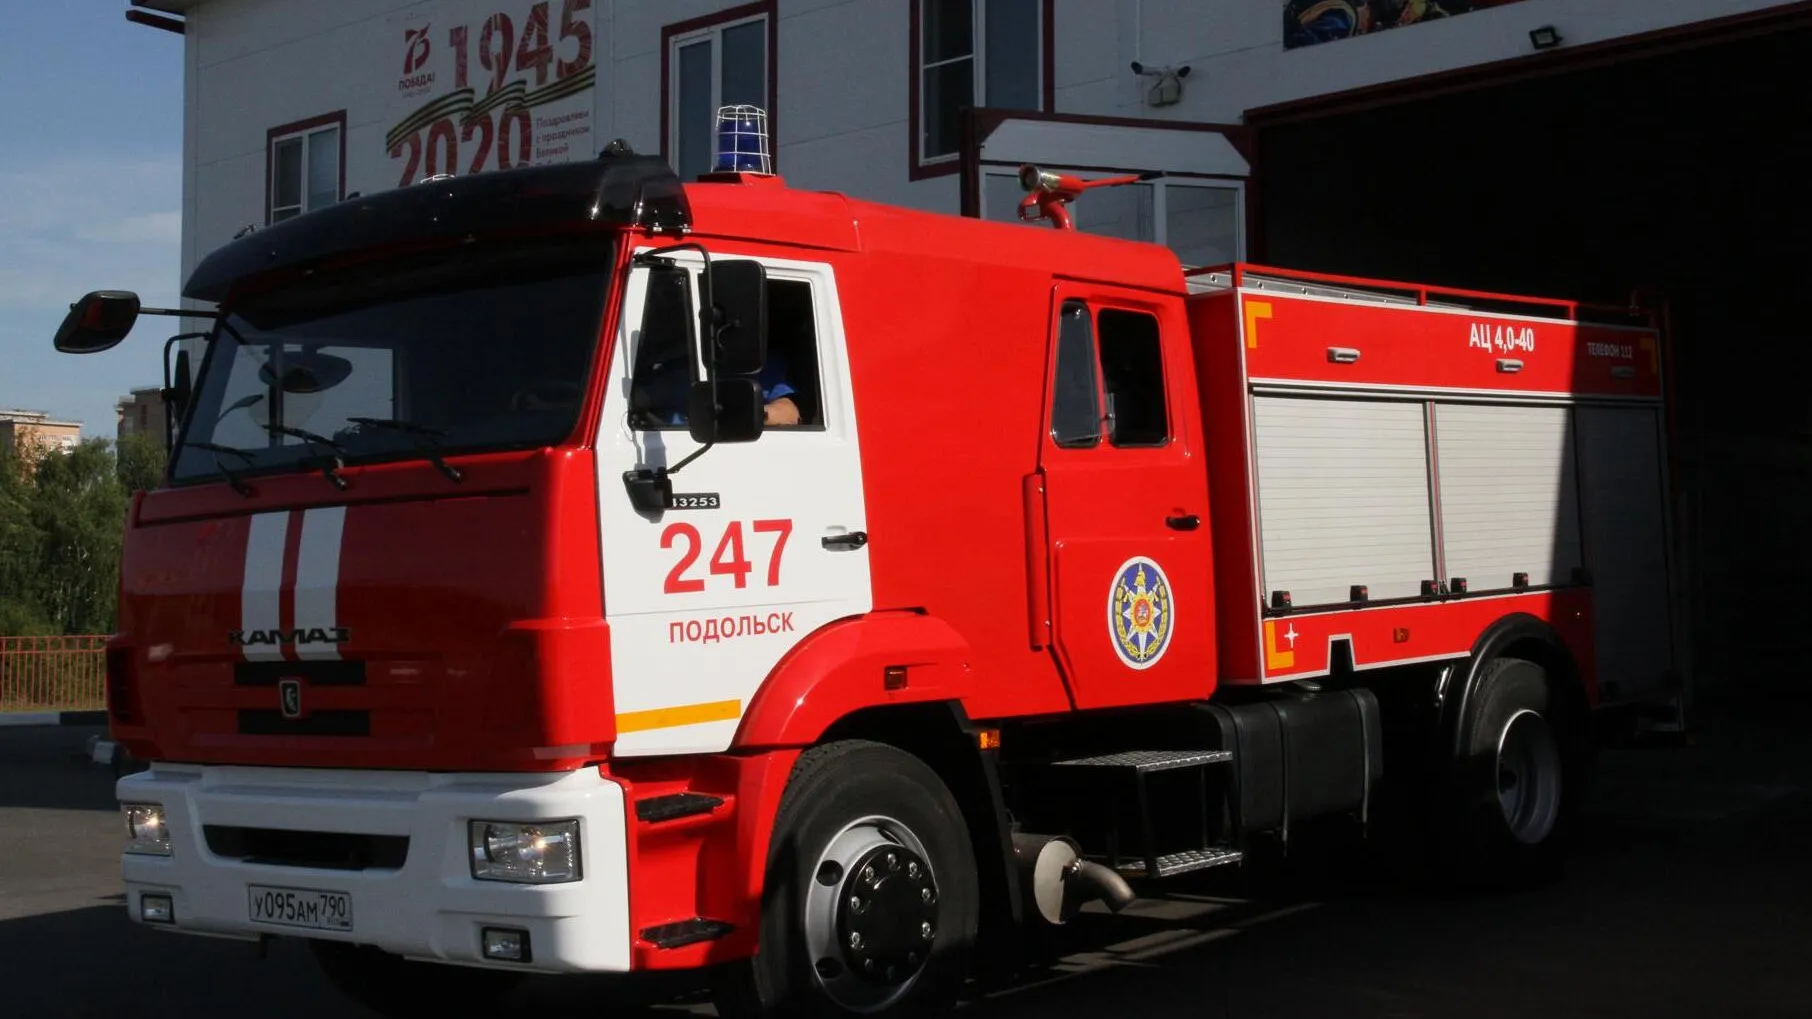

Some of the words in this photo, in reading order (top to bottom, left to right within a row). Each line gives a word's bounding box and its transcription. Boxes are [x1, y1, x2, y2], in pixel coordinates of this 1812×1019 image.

[449, 0, 593, 98] 1945
[390, 107, 533, 188] 2020
[1469, 323, 1492, 353] АЦ
[1494, 325, 1535, 354] 4,0-40
[1587, 341, 1620, 358] ТЕЛЕФОН
[1621, 345, 1633, 359] 112
[660, 518, 793, 594] 247
[228, 627, 350, 646] КАМАЗ
[669, 611, 795, 644] ПОДОЛЬСК
